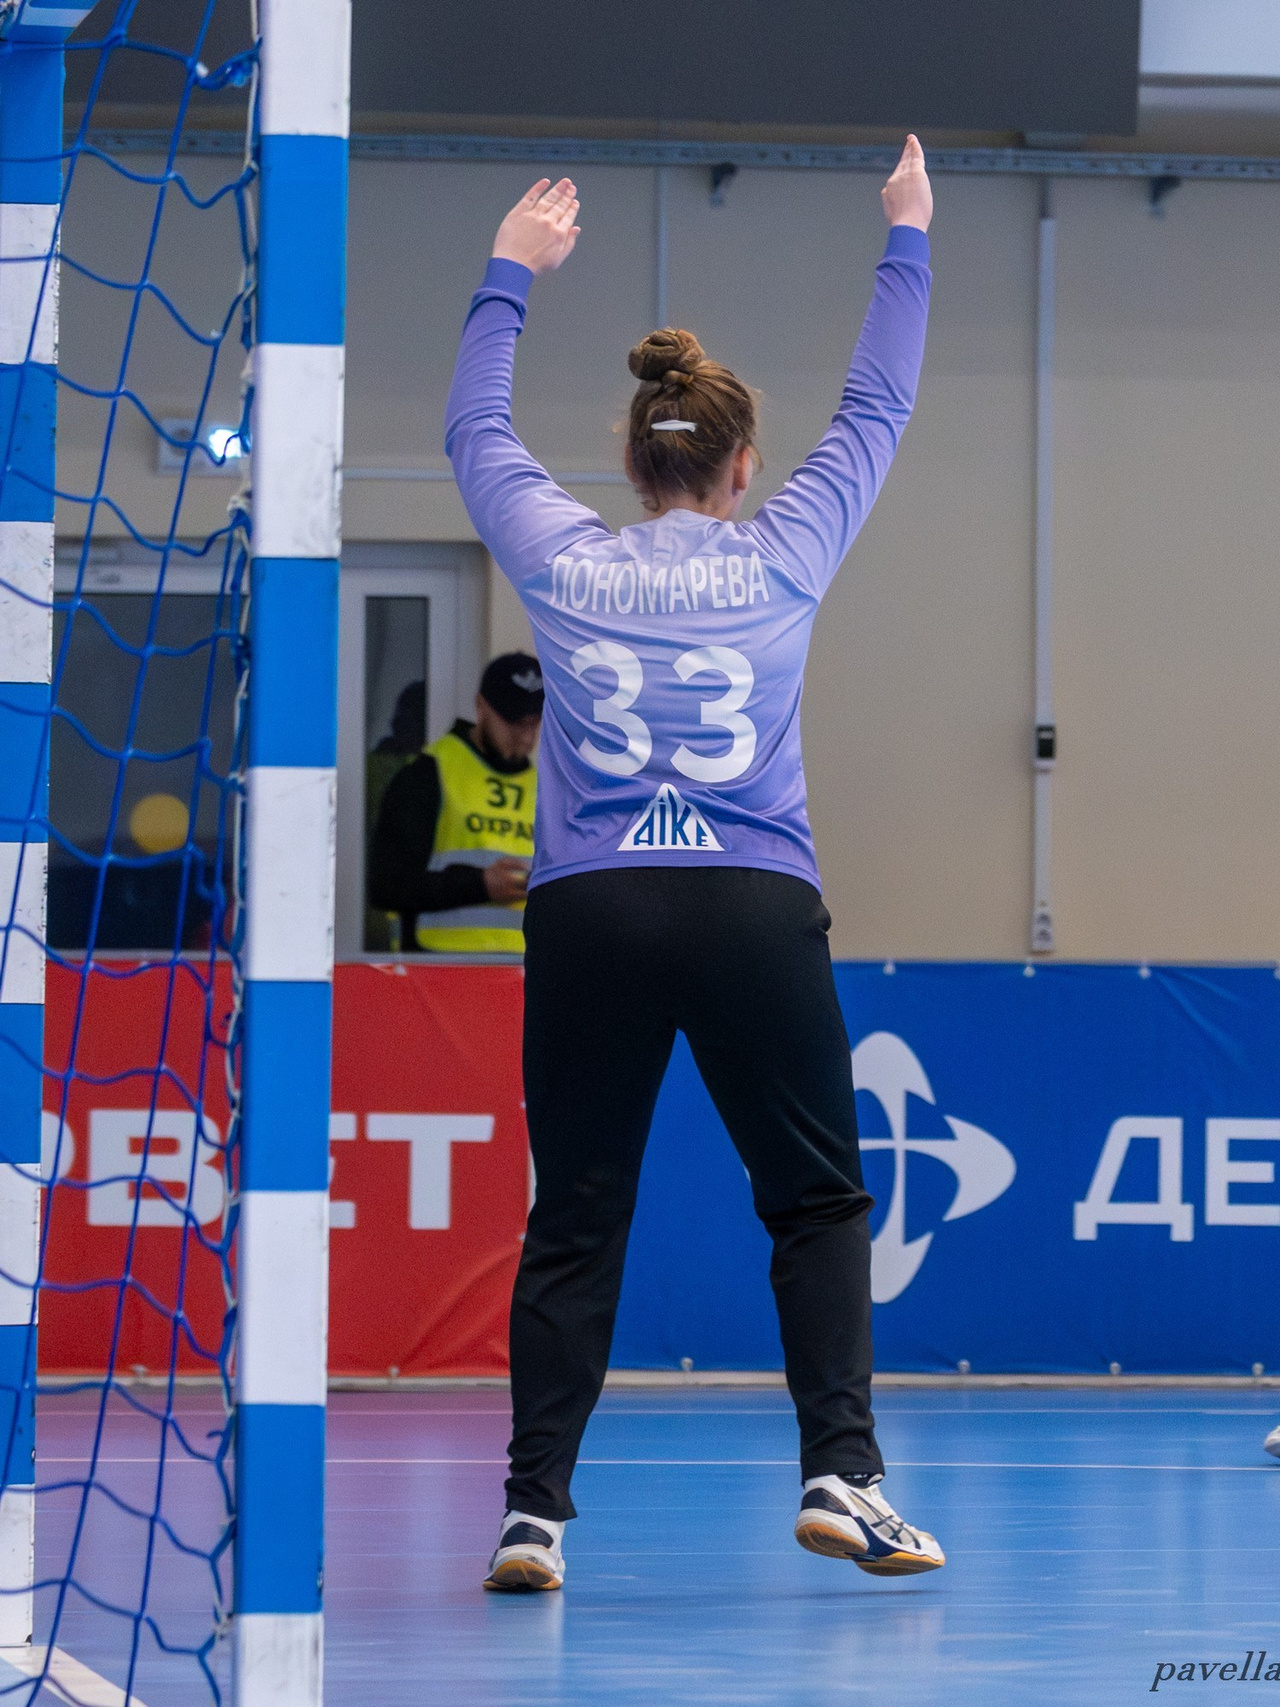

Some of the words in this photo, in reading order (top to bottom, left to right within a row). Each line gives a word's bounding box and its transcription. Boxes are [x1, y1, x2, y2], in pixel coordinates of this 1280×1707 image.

[552, 551, 769, 614] ПОНОМАРЕВА
[570, 640, 757, 783] 33
[486, 777, 523, 811] 37
